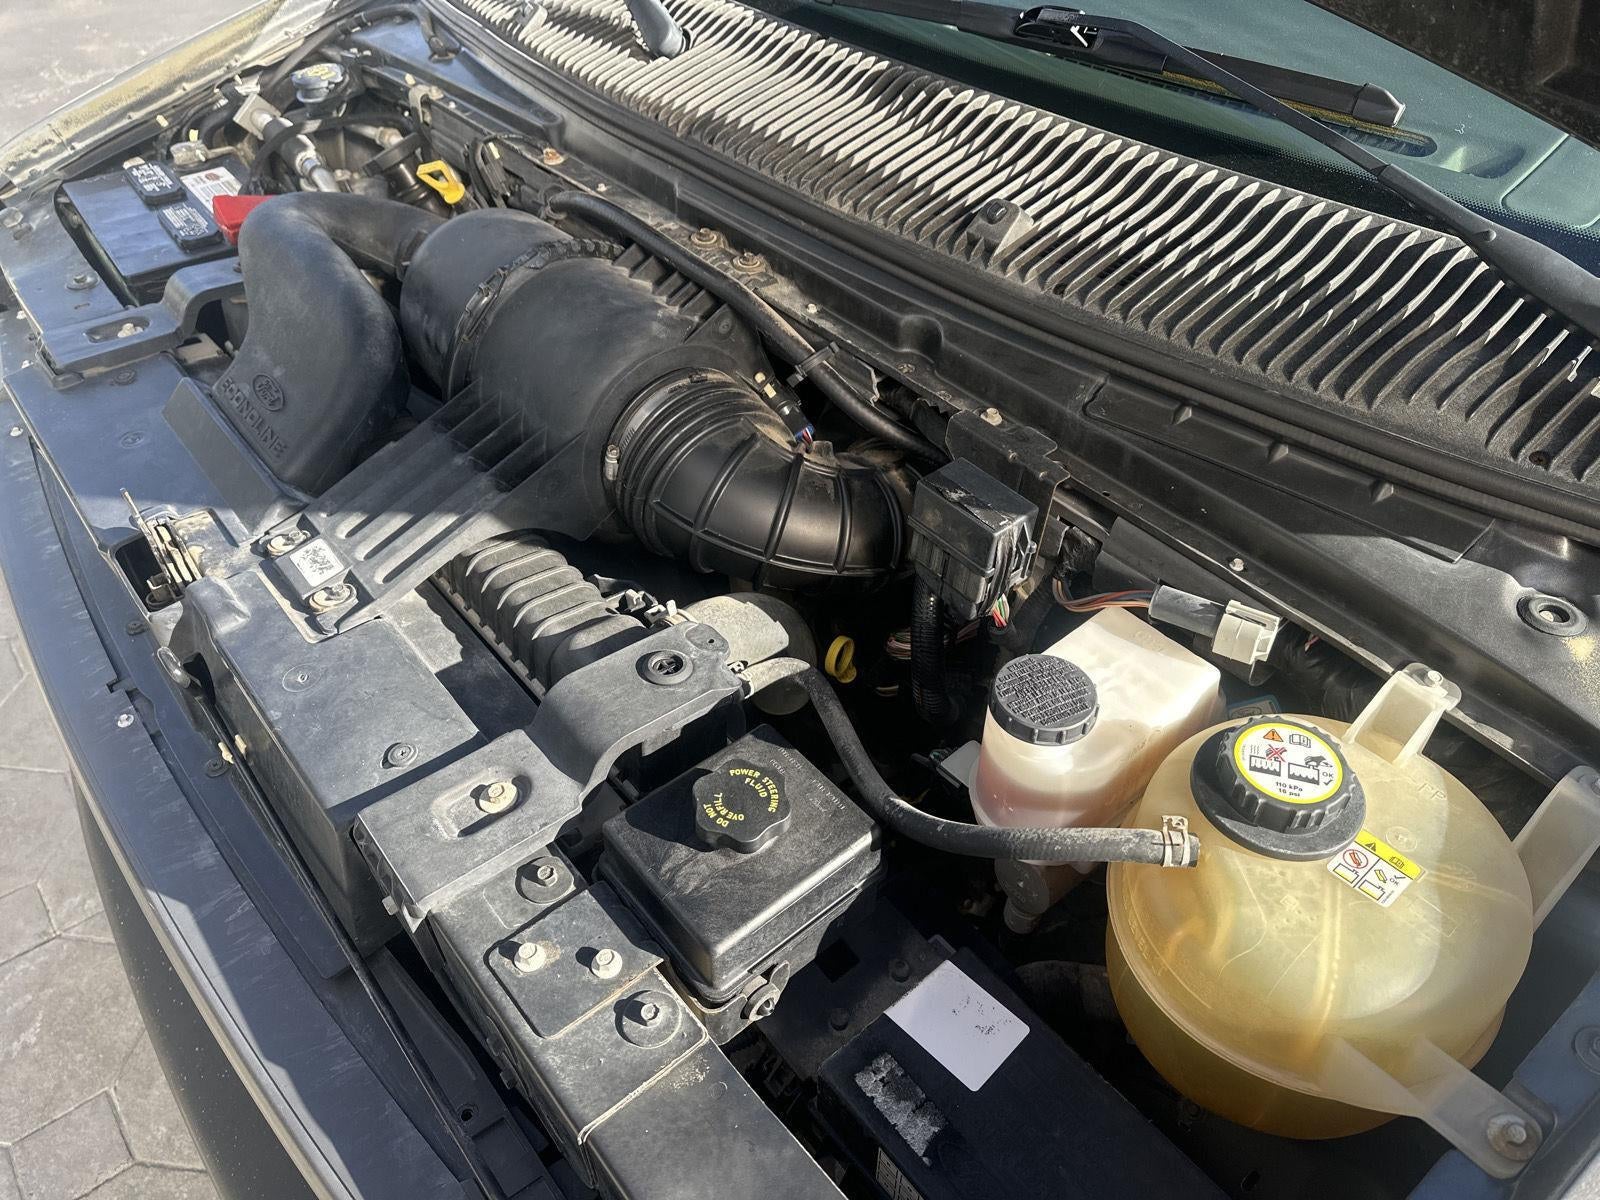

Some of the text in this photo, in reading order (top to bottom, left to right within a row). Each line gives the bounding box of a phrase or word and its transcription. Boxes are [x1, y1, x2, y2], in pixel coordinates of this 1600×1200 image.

[222, 378, 287, 457] ECONOLINE
[744, 777, 768, 798] FLUID
[1322, 771, 1334, 779] OK
[729, 768, 780, 813] POWER STEERING
[1289, 784, 1303, 792] kPa
[703, 803, 730, 828] DO NOT
[713, 792, 745, 821] OVERFILL
